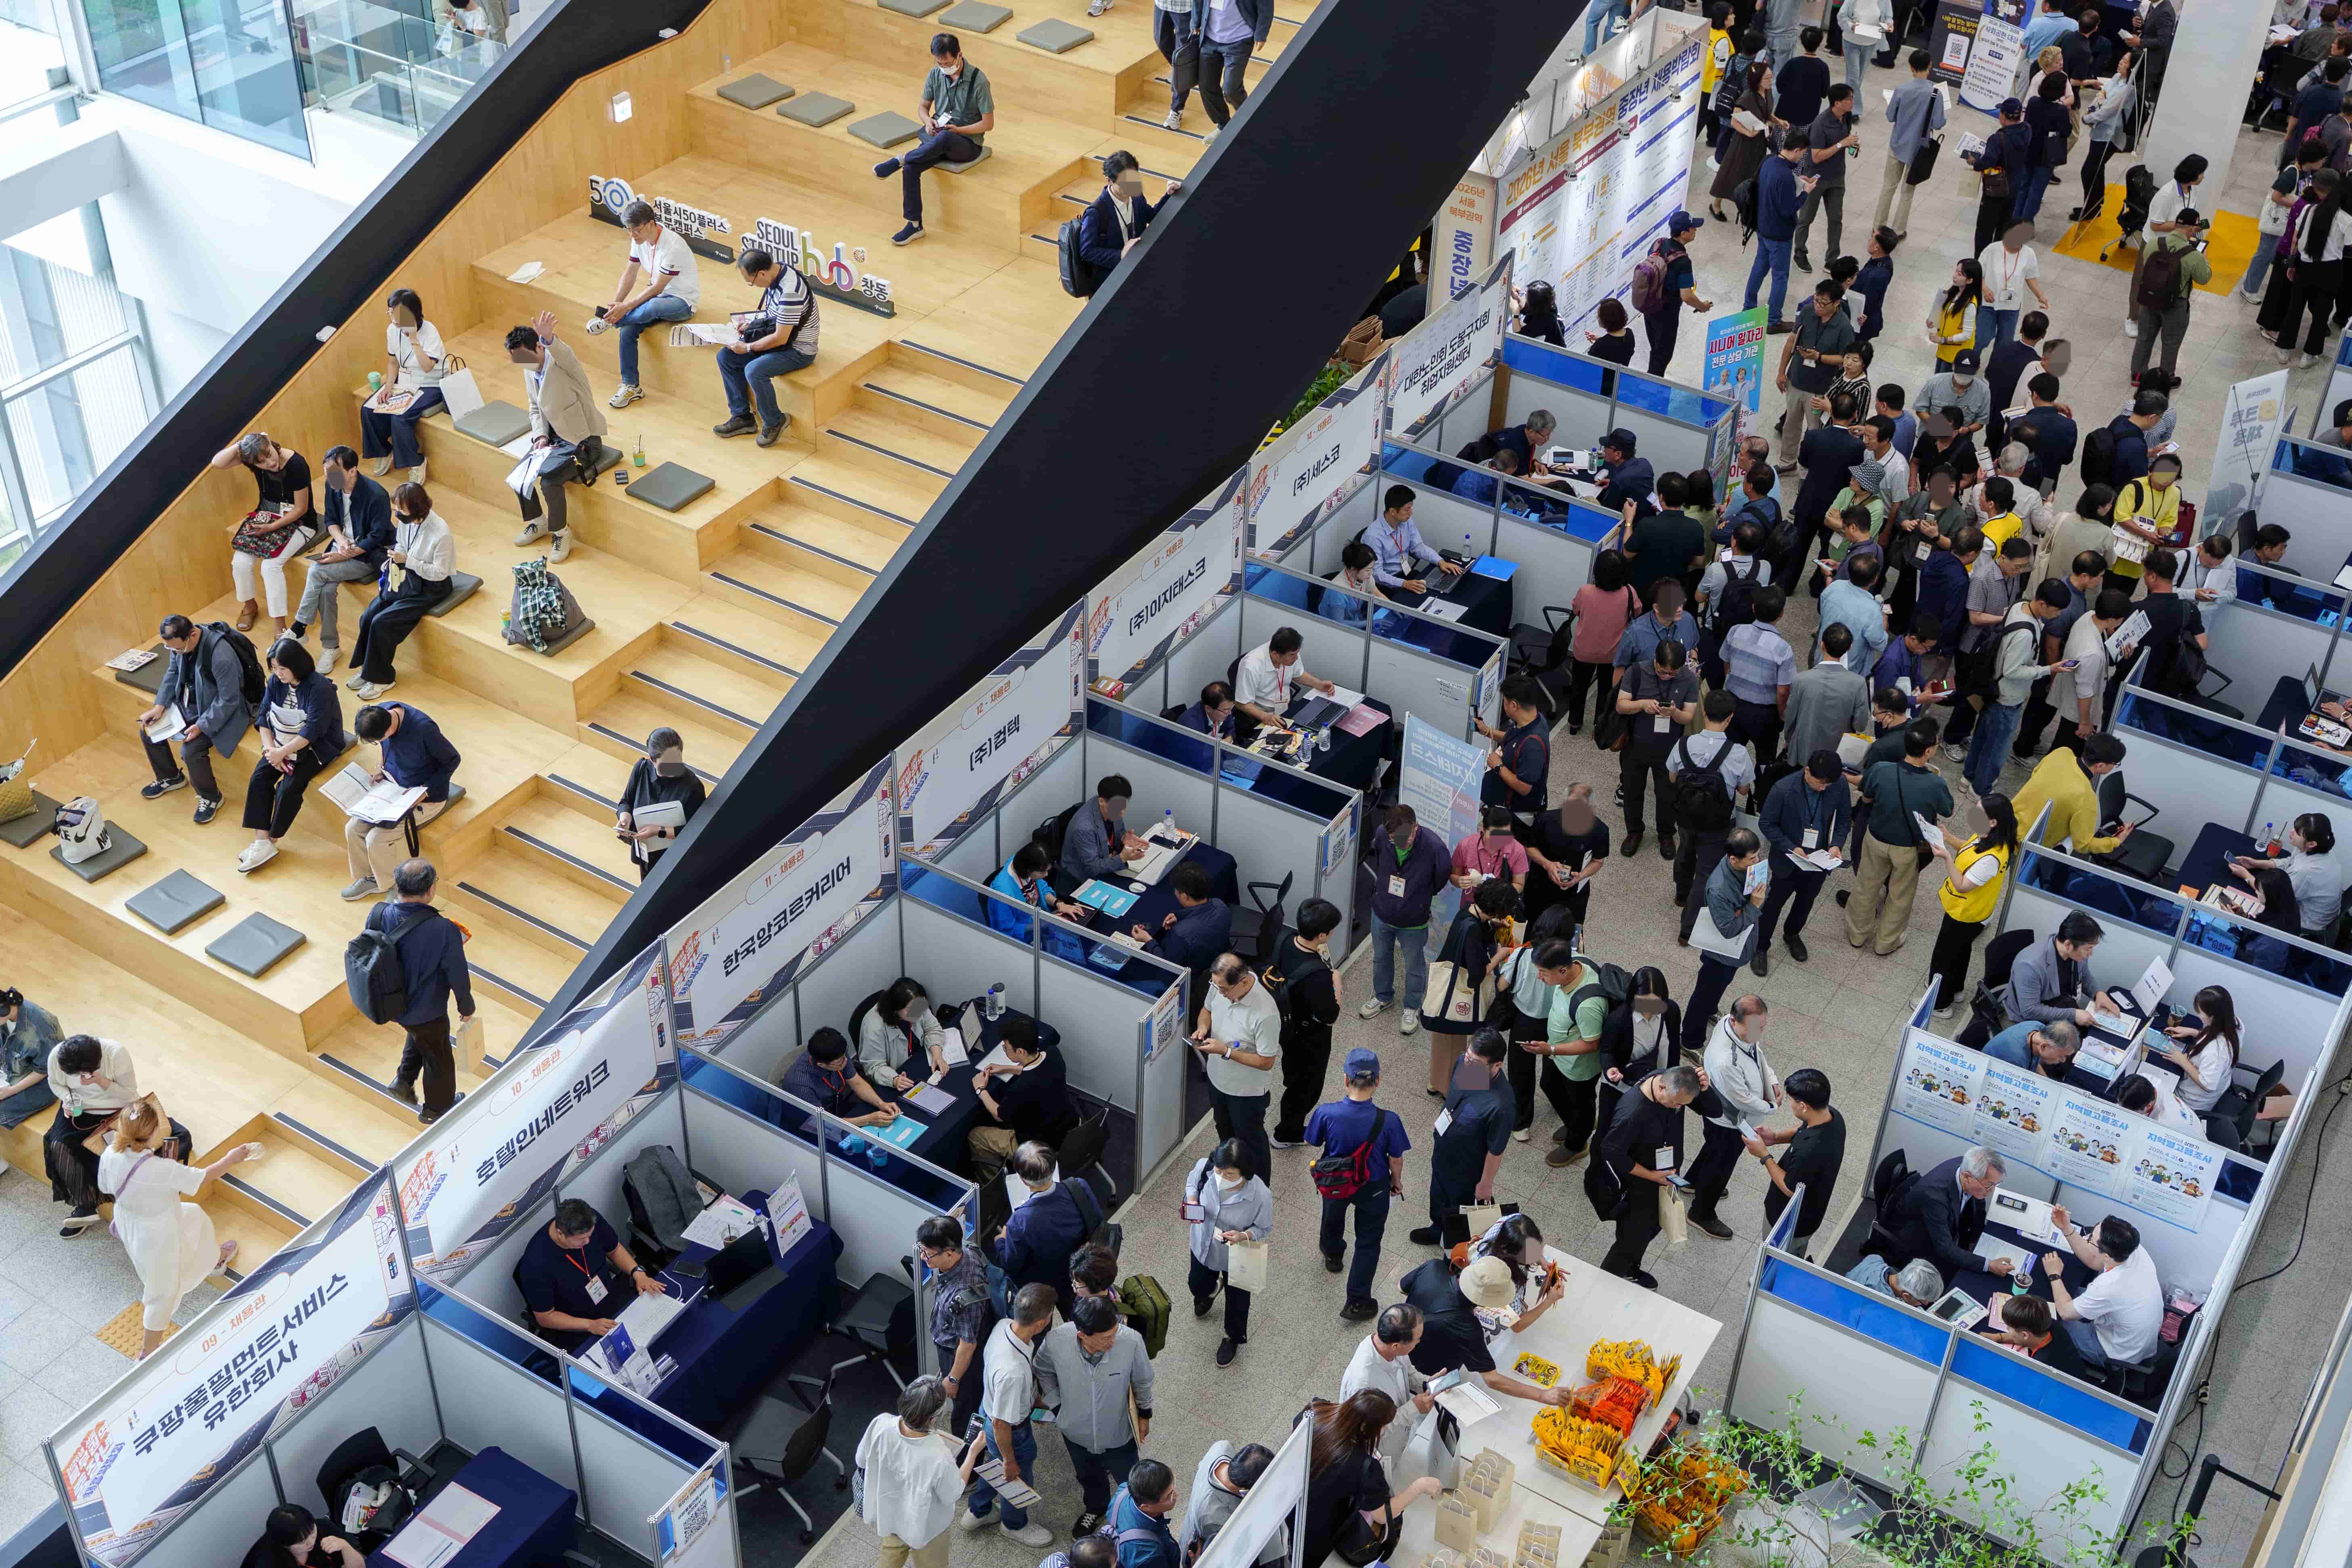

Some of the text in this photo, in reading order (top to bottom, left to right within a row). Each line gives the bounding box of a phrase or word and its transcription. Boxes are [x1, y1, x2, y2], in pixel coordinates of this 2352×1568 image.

[1506, 157, 1545, 207] 2026년
[1547, 139, 1570, 174] 서울
[1573, 103, 1617, 152] 북부권역
[1618, 77, 1650, 120] 중장년
[1652, 39, 1701, 93] 채용박람회
[1454, 183, 1486, 198] 026년
[1459, 196, 1476, 208] 서울
[653, 199, 728, 234] 서울시50플러스
[1449, 206, 1483, 224] 북부권역
[756, 220, 798, 252] SEOUL
[1449, 229, 1473, 297] 중장년
[861, 277, 888, 301] 창동
[1403, 344, 1447, 394] 대한노인회
[1448, 308, 1491, 356] 도봉구지회
[1709, 326, 1764, 355] 시니어 일자리
[1420, 342, 1472, 398] 취업지원센터
[1711, 345, 1759, 369] 전문 상담 기관
[1317, 413, 1333, 431] 채용관
[1293, 443, 1340, 497] (주)세스코
[1154, 557, 1160, 569] 13
[1166, 537, 1183, 559] 채용관
[1129, 557, 1206, 636] (주)이지태스크
[976, 703, 983, 715] 12
[990, 680, 1011, 704] 채용관
[765, 876, 772, 887] 11
[779, 849, 805, 876] 채용관
[723, 856, 852, 978] 한국앙코르커리어
[1916, 1042, 1977, 1072] 지역별고용조사
[1950, 1050, 1964, 1059] 상반기
[511, 1080, 522, 1097] 10
[531, 1049, 561, 1081] 채용관
[1985, 1068, 2048, 1098] 지역별고용조사
[2021, 1077, 2036, 1085] 상반기
[476, 1059, 610, 1187] 호텔인네트워크
[2065, 1100, 2130, 1130] 지역별고용조사
[2101, 1109, 2116, 1118] 상반기
[2147, 1132, 2213, 1164] 지역별고용조사
[2184, 1142, 2200, 1150] 상반기
[201, 1333, 218, 1354] 09
[229, 1293, 267, 1329] 채용관
[133, 1273, 349, 1457] 쿠팡풀필먼트서비스
[203, 1339, 299, 1432] 유한회사
